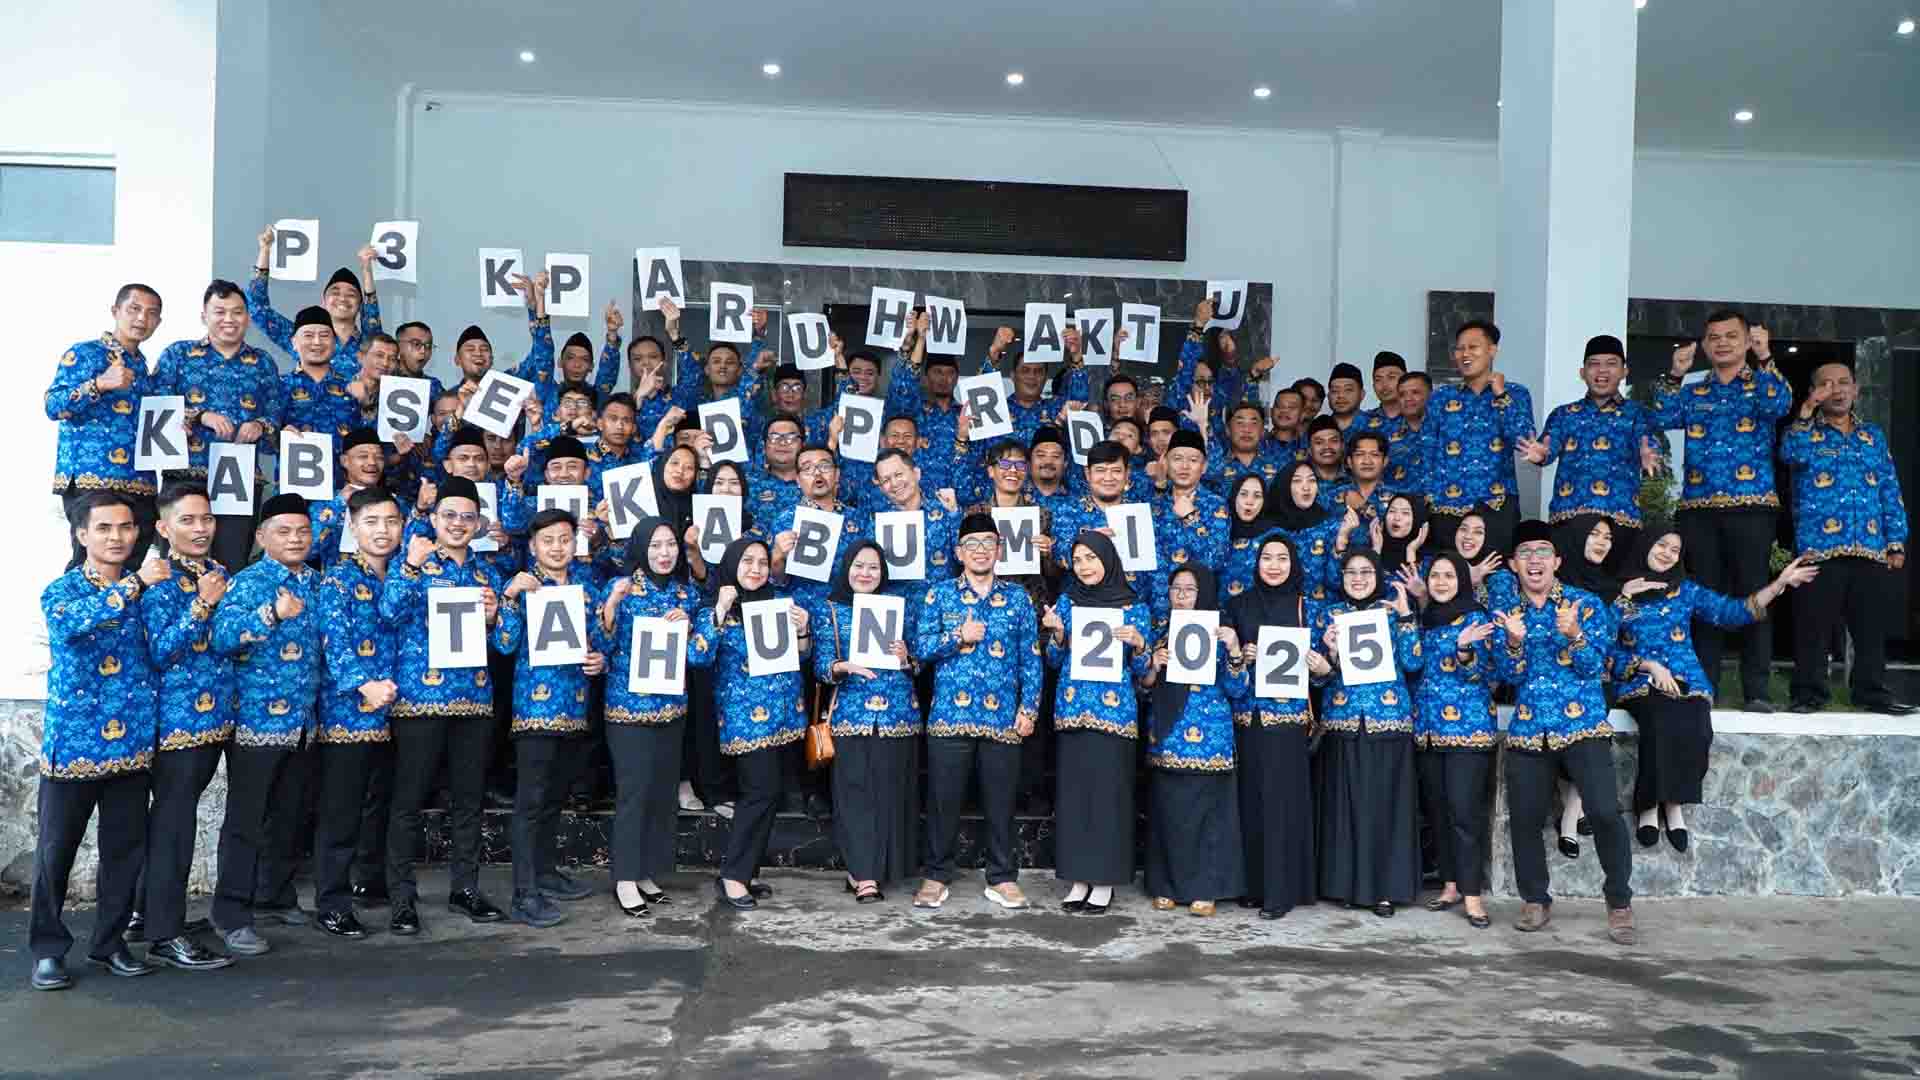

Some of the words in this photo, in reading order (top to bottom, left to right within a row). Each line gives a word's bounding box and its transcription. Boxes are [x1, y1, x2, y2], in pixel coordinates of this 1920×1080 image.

[276, 229, 310, 269] P
[377, 231, 407, 270] 3
[486, 259, 519, 296] K
[551, 265, 582, 304] P
[646, 259, 680, 298] A
[716, 293, 746, 331] R
[872, 299, 908, 338] H
[930, 304, 962, 343] W
[1214, 290, 1241, 320] U
[799, 322, 828, 359] U
[1028, 314, 1061, 352] A
[1081, 319, 1107, 355] K
[1128, 314, 1155, 351] T
[386, 389, 420, 431] S
[479, 377, 520, 424] E
[968, 386, 1001, 428] R
[141, 409, 181, 456] K
[705, 413, 738, 453] D
[842, 407, 873, 446] P
[1072, 419, 1100, 456] D
[210, 456, 248, 502] A
[288, 443, 324, 487] B
[609, 476, 648, 525] K
[701, 507, 734, 550] A
[794, 519, 831, 567] B
[884, 524, 917, 567] U
[998, 519, 1033, 562] M
[1126, 515, 1139, 559] I
[437, 602, 477, 652] T
[535, 600, 581, 651] A
[750, 612, 790, 660] U
[857, 608, 897, 655] N
[1081, 621, 1114, 668] 2
[1348, 623, 1383, 670] 5
[638, 630, 679, 680] H
[1265, 640, 1300, 685] 2
